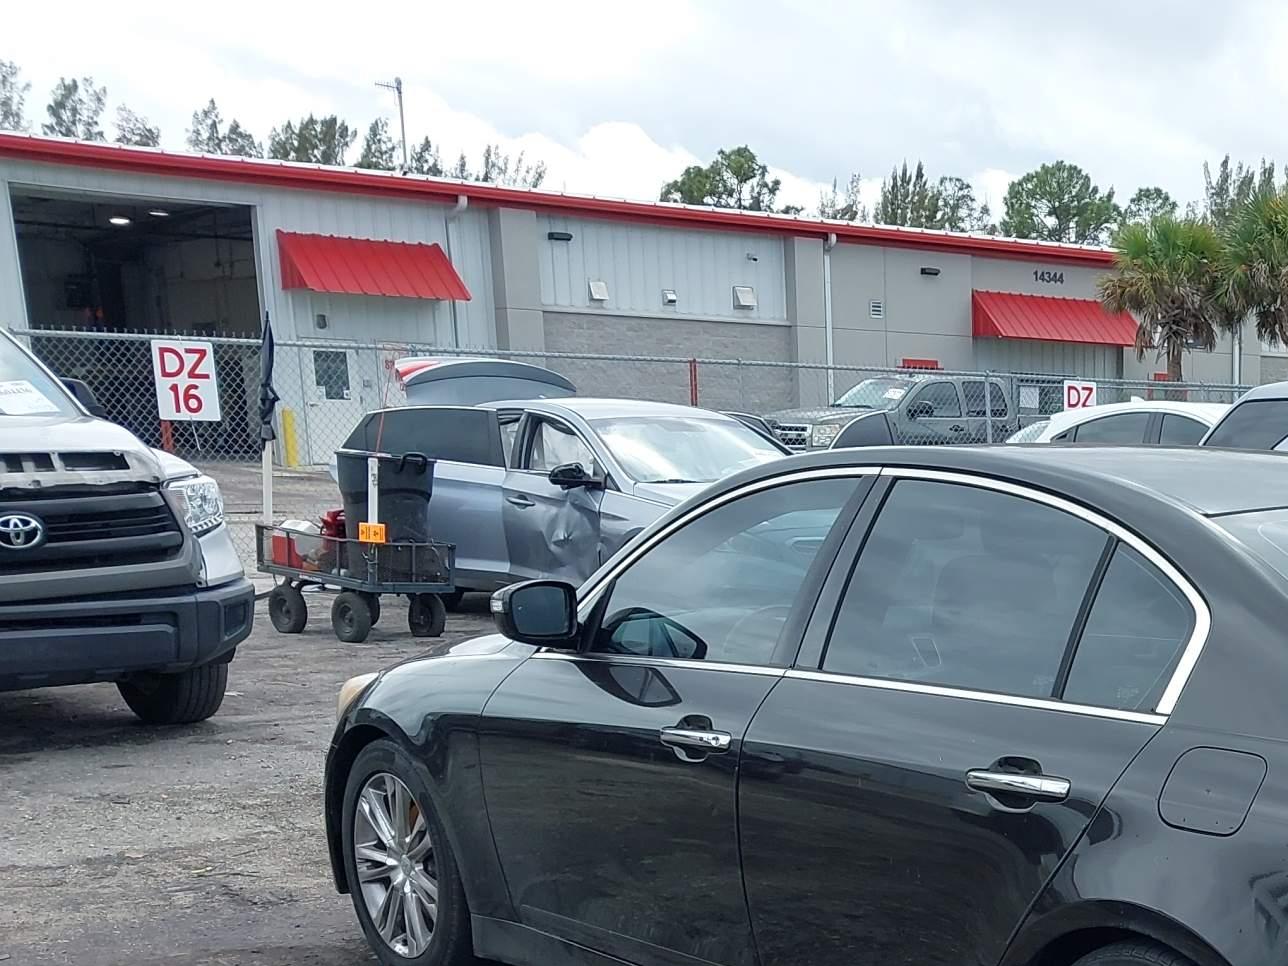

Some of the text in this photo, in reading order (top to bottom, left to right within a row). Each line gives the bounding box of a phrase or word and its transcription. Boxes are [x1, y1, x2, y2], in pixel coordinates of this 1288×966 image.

[1033, 270, 1065, 284] 14344
[158, 347, 210, 379] DZ
[169, 383, 203, 414] 16
[1067, 385, 1094, 408] DZ
